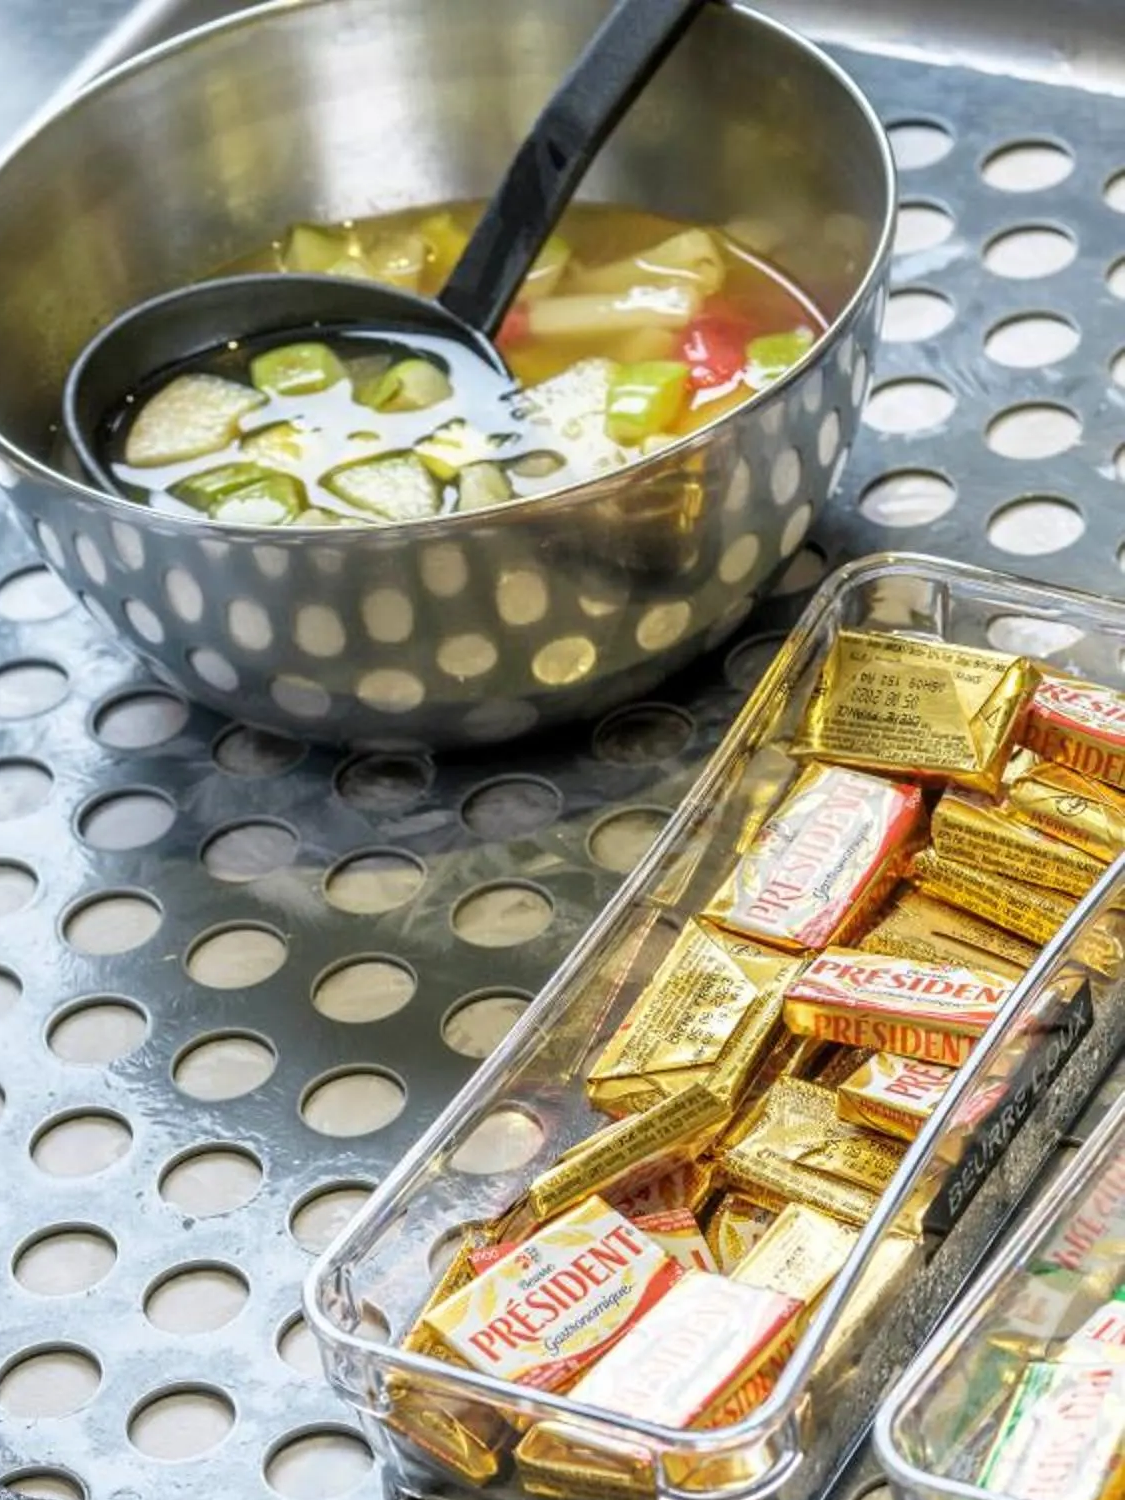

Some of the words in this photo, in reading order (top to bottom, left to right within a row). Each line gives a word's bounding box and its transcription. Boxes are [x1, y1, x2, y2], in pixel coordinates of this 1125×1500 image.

[811, 957, 1007, 1005] PRÉSIDEN
[948, 1089, 1029, 1218] BEURRE
[467, 1224, 645, 1365] PRÉSIDENT
